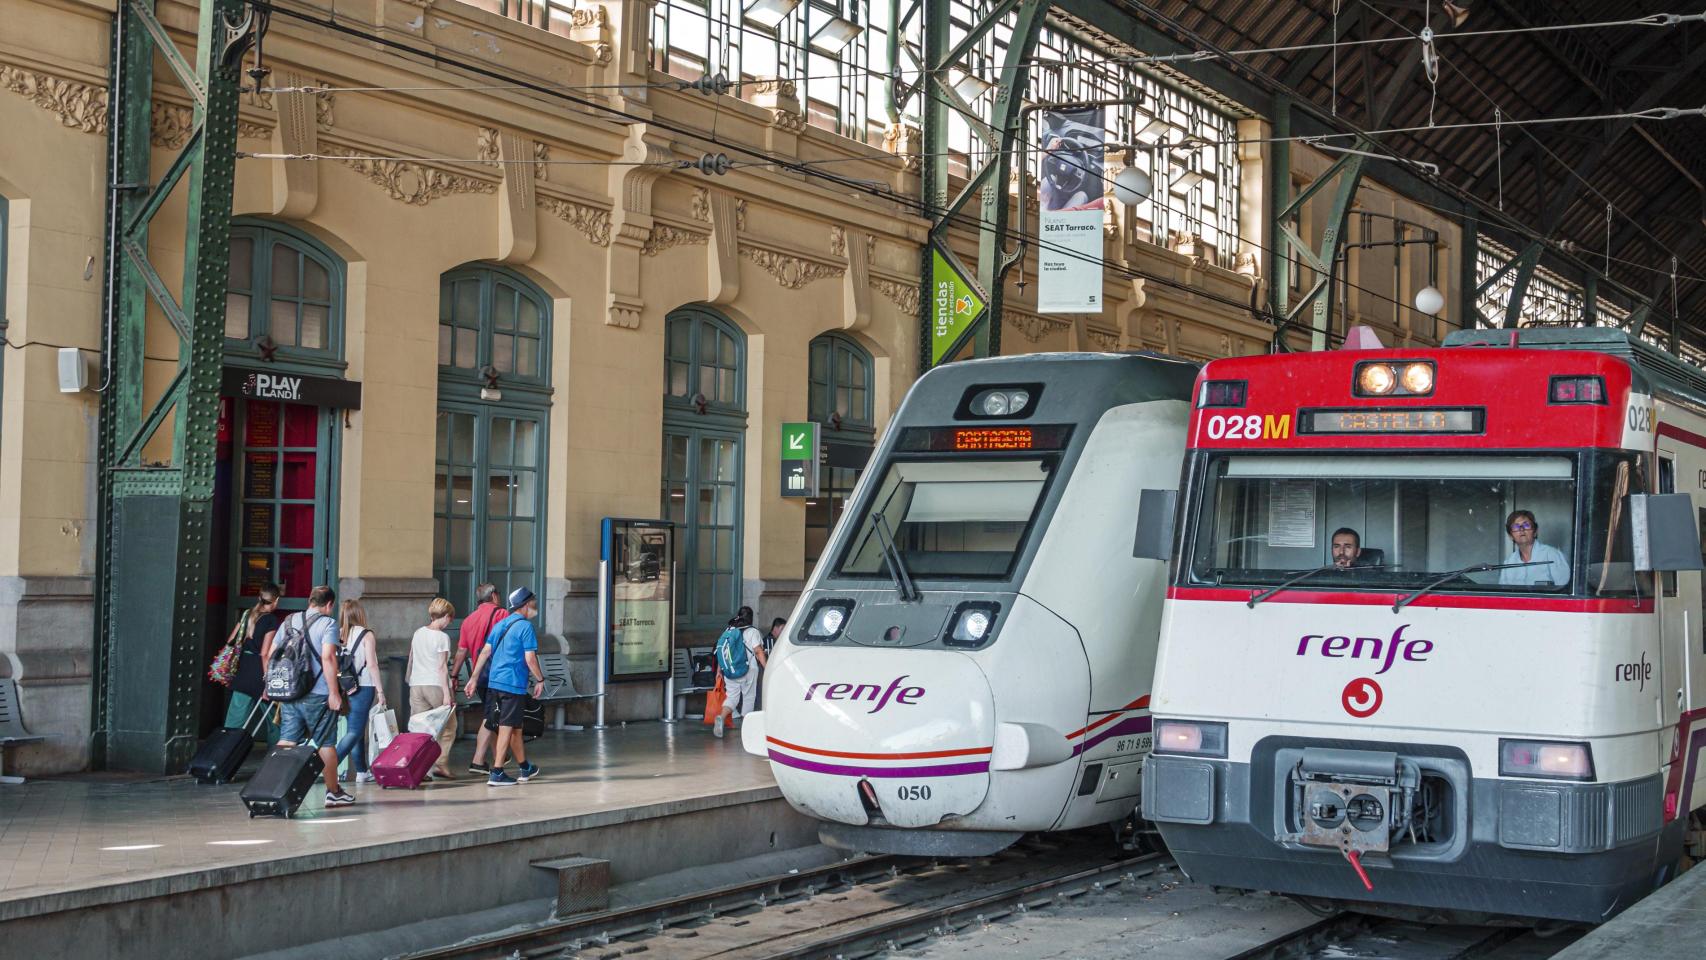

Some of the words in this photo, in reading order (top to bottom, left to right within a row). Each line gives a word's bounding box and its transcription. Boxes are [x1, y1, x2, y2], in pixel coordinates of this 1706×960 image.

[936, 281, 947, 337] tiendas
[256, 374, 301, 400] PLAY
[1207, 414, 1290, 440] 028M
[1296, 623, 1434, 675] renfe
[1615, 650, 1652, 693] renfe
[804, 675, 926, 714] renfe
[1117, 740, 1125, 751] 96
[1127, 739, 1135, 750] 71
[1136, 738, 1141, 749] 9
[897, 785, 932, 801] 050
